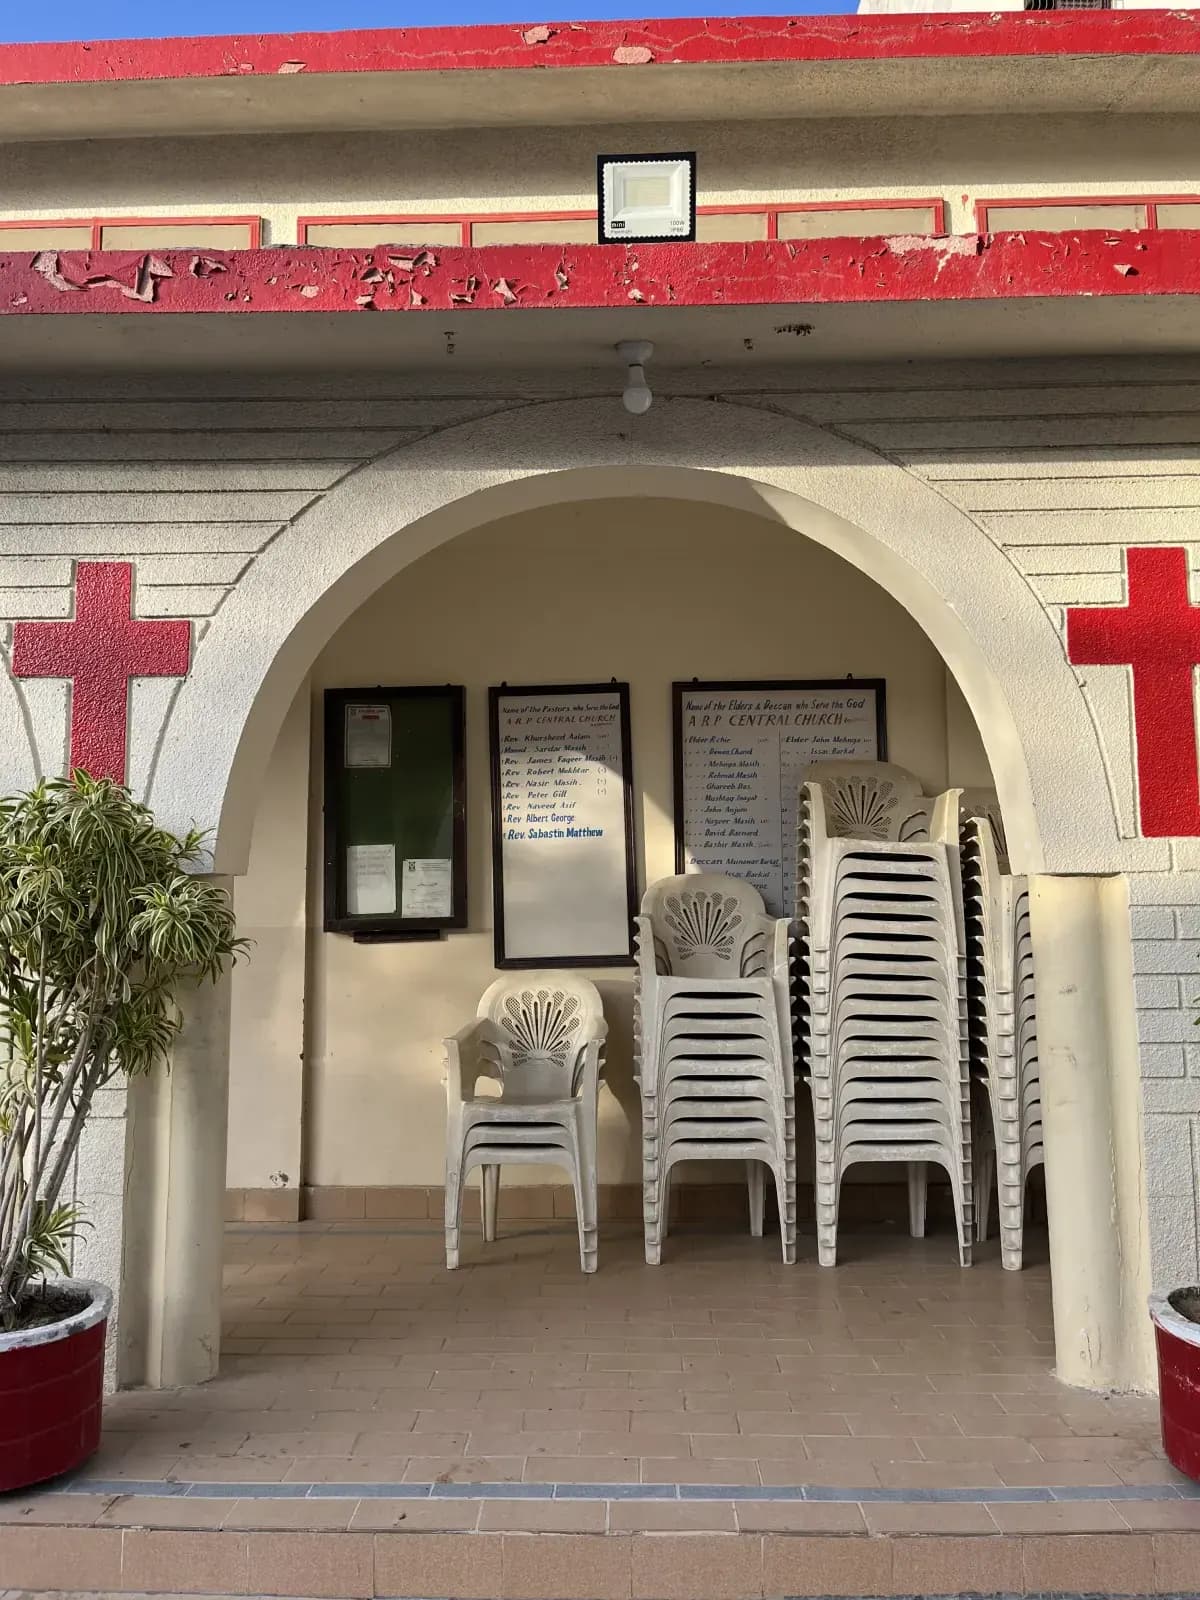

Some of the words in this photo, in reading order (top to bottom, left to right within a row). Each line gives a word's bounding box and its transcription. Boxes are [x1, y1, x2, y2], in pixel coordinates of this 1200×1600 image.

[542, 704, 570, 712] Pastors
[714, 700, 726, 711] the
[728, 699, 755, 711] Elders
[796, 700, 808, 710] who
[811, 699, 829, 710] Serve
[832, 701, 844, 709] the
[846, 698, 866, 709] God
[536, 715, 576, 724] CENTRAL
[579, 713, 616, 723] CHURCH
[689, 714, 696, 727] A
[701, 714, 711, 727] R
[714, 714, 722, 726] P
[728, 713, 790, 727] CENTRAL
[793, 712, 843, 726] CHURCH
[526, 755, 552, 764] James
[585, 753, 606, 762] Masih
[526, 767, 554, 776] Robert
[525, 778, 550, 787] Nasir
[527, 790, 548, 799] Peter
[552, 788, 568, 798] Gill
[527, 801, 556, 810] Naveed
[559, 800, 577, 809] Asif
[526, 813, 548, 822] Albert
[551, 812, 575, 824] George
[733, 816, 756, 825] Masih
[528, 827, 565, 839] Sabastin
[566, 826, 603, 838] Matthew
[704, 828, 726, 837] David
[703, 840, 729, 848] Bashir
[690, 857, 723, 865] Deccan
[745, 869, 771, 878] Barkat
